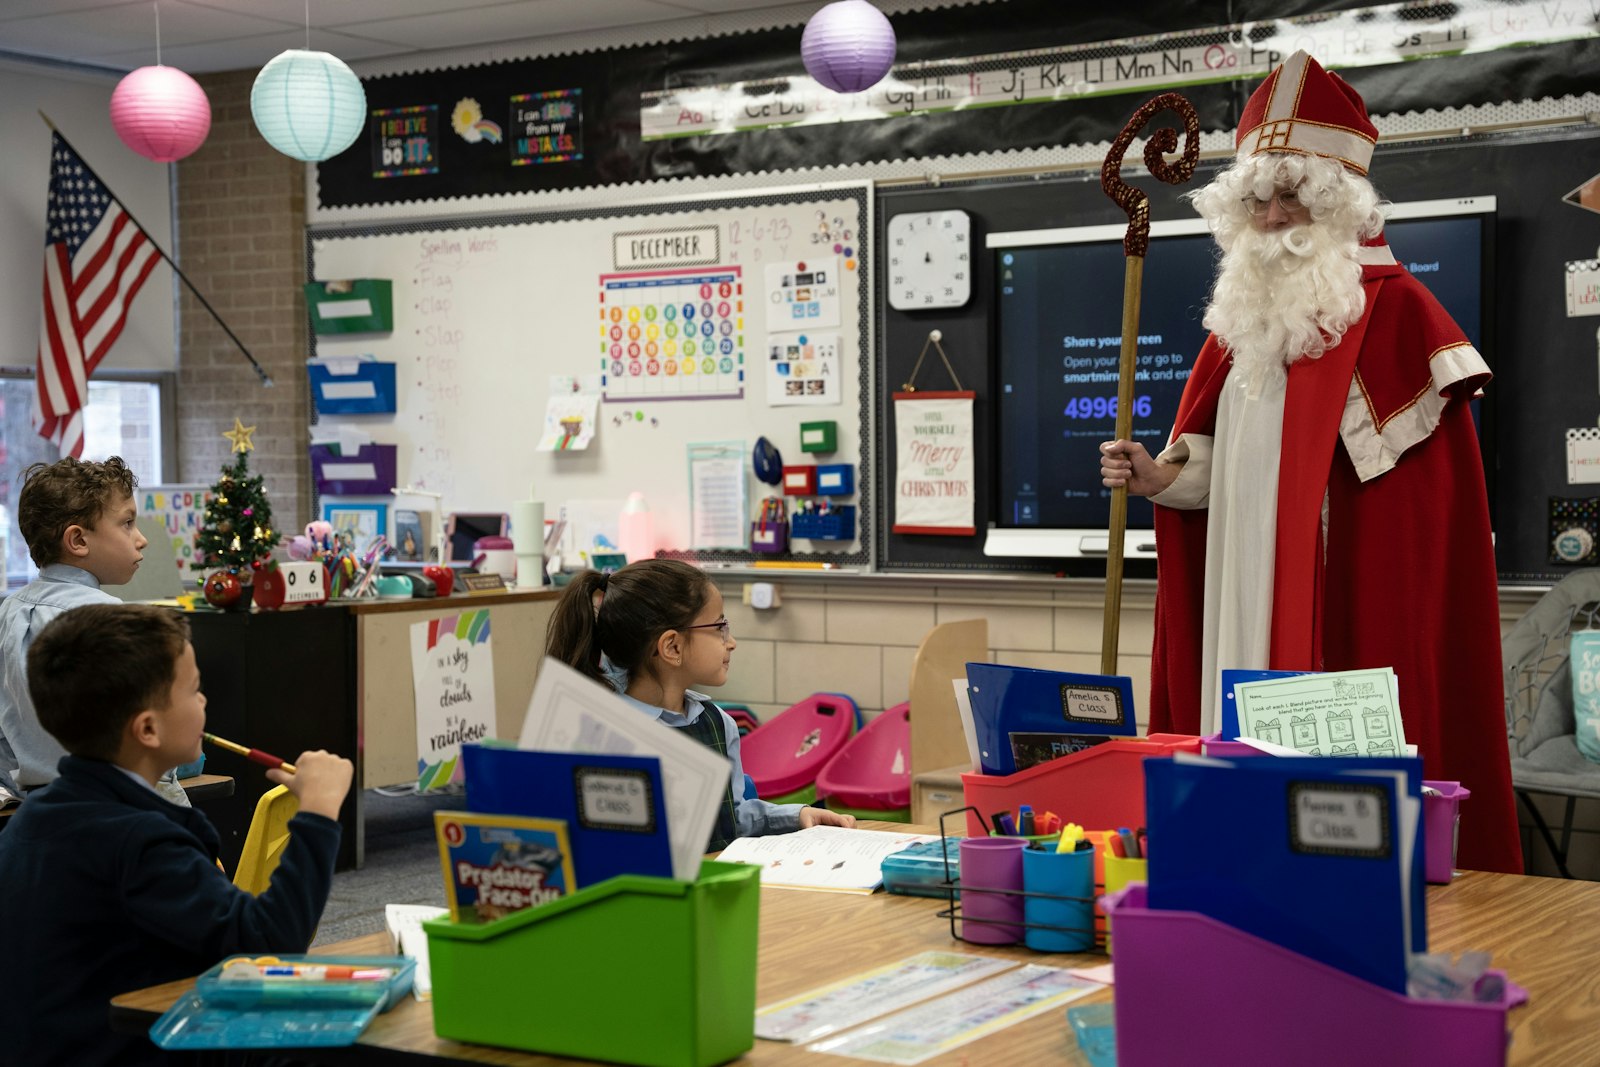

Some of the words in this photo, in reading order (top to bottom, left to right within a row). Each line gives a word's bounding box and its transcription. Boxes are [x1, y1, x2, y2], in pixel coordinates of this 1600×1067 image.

[677, 108, 704, 125] Aa
[1002, 68, 1025, 102] Jj
[1040, 63, 1066, 88] Kk
[1084, 60, 1104, 84] Ll
[1116, 56, 1156, 81] Mm
[1162, 50, 1193, 76] Nn
[1202, 44, 1238, 70] Oo
[518, 109, 524, 123] I
[524, 110, 540, 122] can
[388, 116, 427, 136] BELIEVE
[526, 122, 549, 136] from
[551, 122, 566, 135] my
[518, 134, 575, 154] MISTAKES.
[383, 147, 403, 166] DO
[420, 239, 462, 263] Spelling
[631, 235, 701, 260] DECEMBER
[1410, 261, 1439, 273] Board
[425, 325, 464, 352] Slap
[1063, 335, 1096, 348] Share
[1063, 356, 1092, 369] Open
[1094, 356, 1117, 369] your
[1142, 355, 1153, 365] or
[1155, 355, 1169, 368] go
[1171, 353, 1183, 364] to
[1152, 368, 1173, 380] and
[1175, 368, 1192, 380] ent
[1063, 395, 1152, 419] 49966
[910, 440, 965, 473] Merry
[901, 480, 969, 497] CHRISTMAS
[288, 571, 296, 586] 0
[309, 569, 316, 584] 6
[453, 647, 469, 673] sky
[440, 683, 472, 707] clouds
[1069, 690, 1101, 701] Amelia
[1078, 703, 1107, 714] Class
[430, 718, 488, 751] rainbow
[447, 826, 458, 842] 1
[458, 861, 545, 889] Predator
